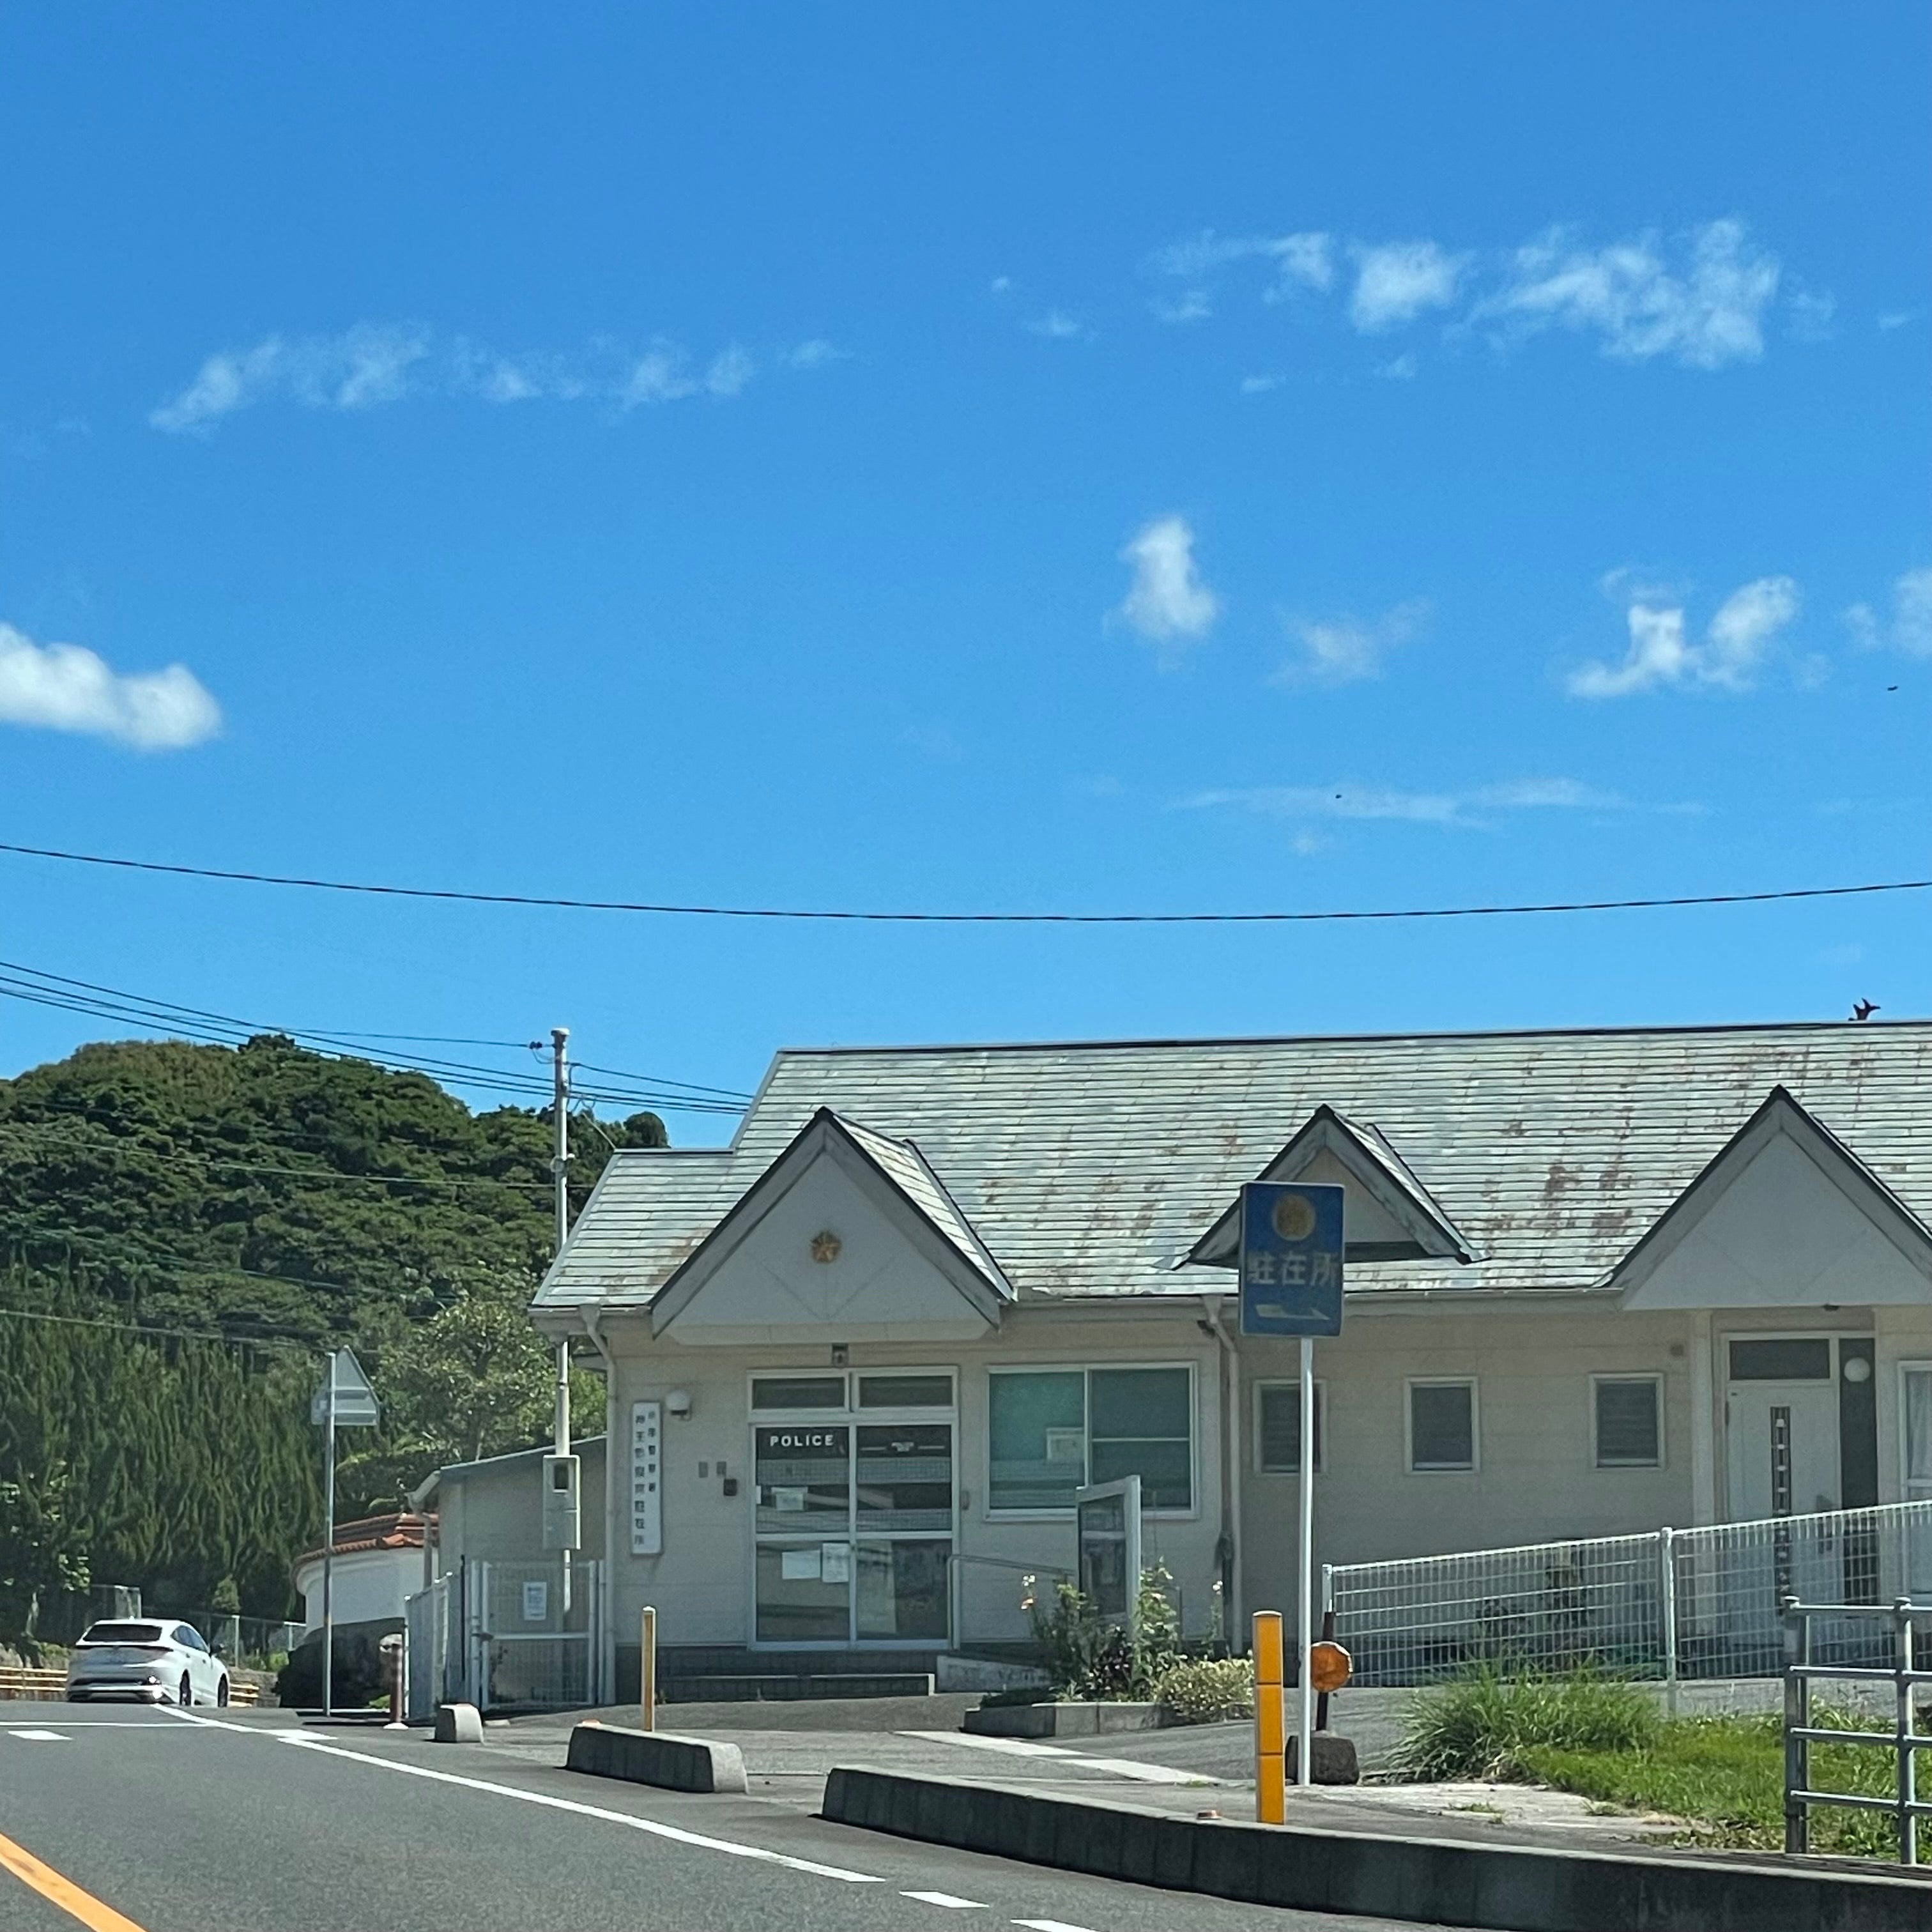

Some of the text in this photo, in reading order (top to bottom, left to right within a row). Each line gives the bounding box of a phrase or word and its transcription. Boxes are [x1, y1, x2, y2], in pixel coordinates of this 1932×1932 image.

[1246, 1250, 1339, 1288] 駐在所
[770, 1434, 834, 1447] POLICE
